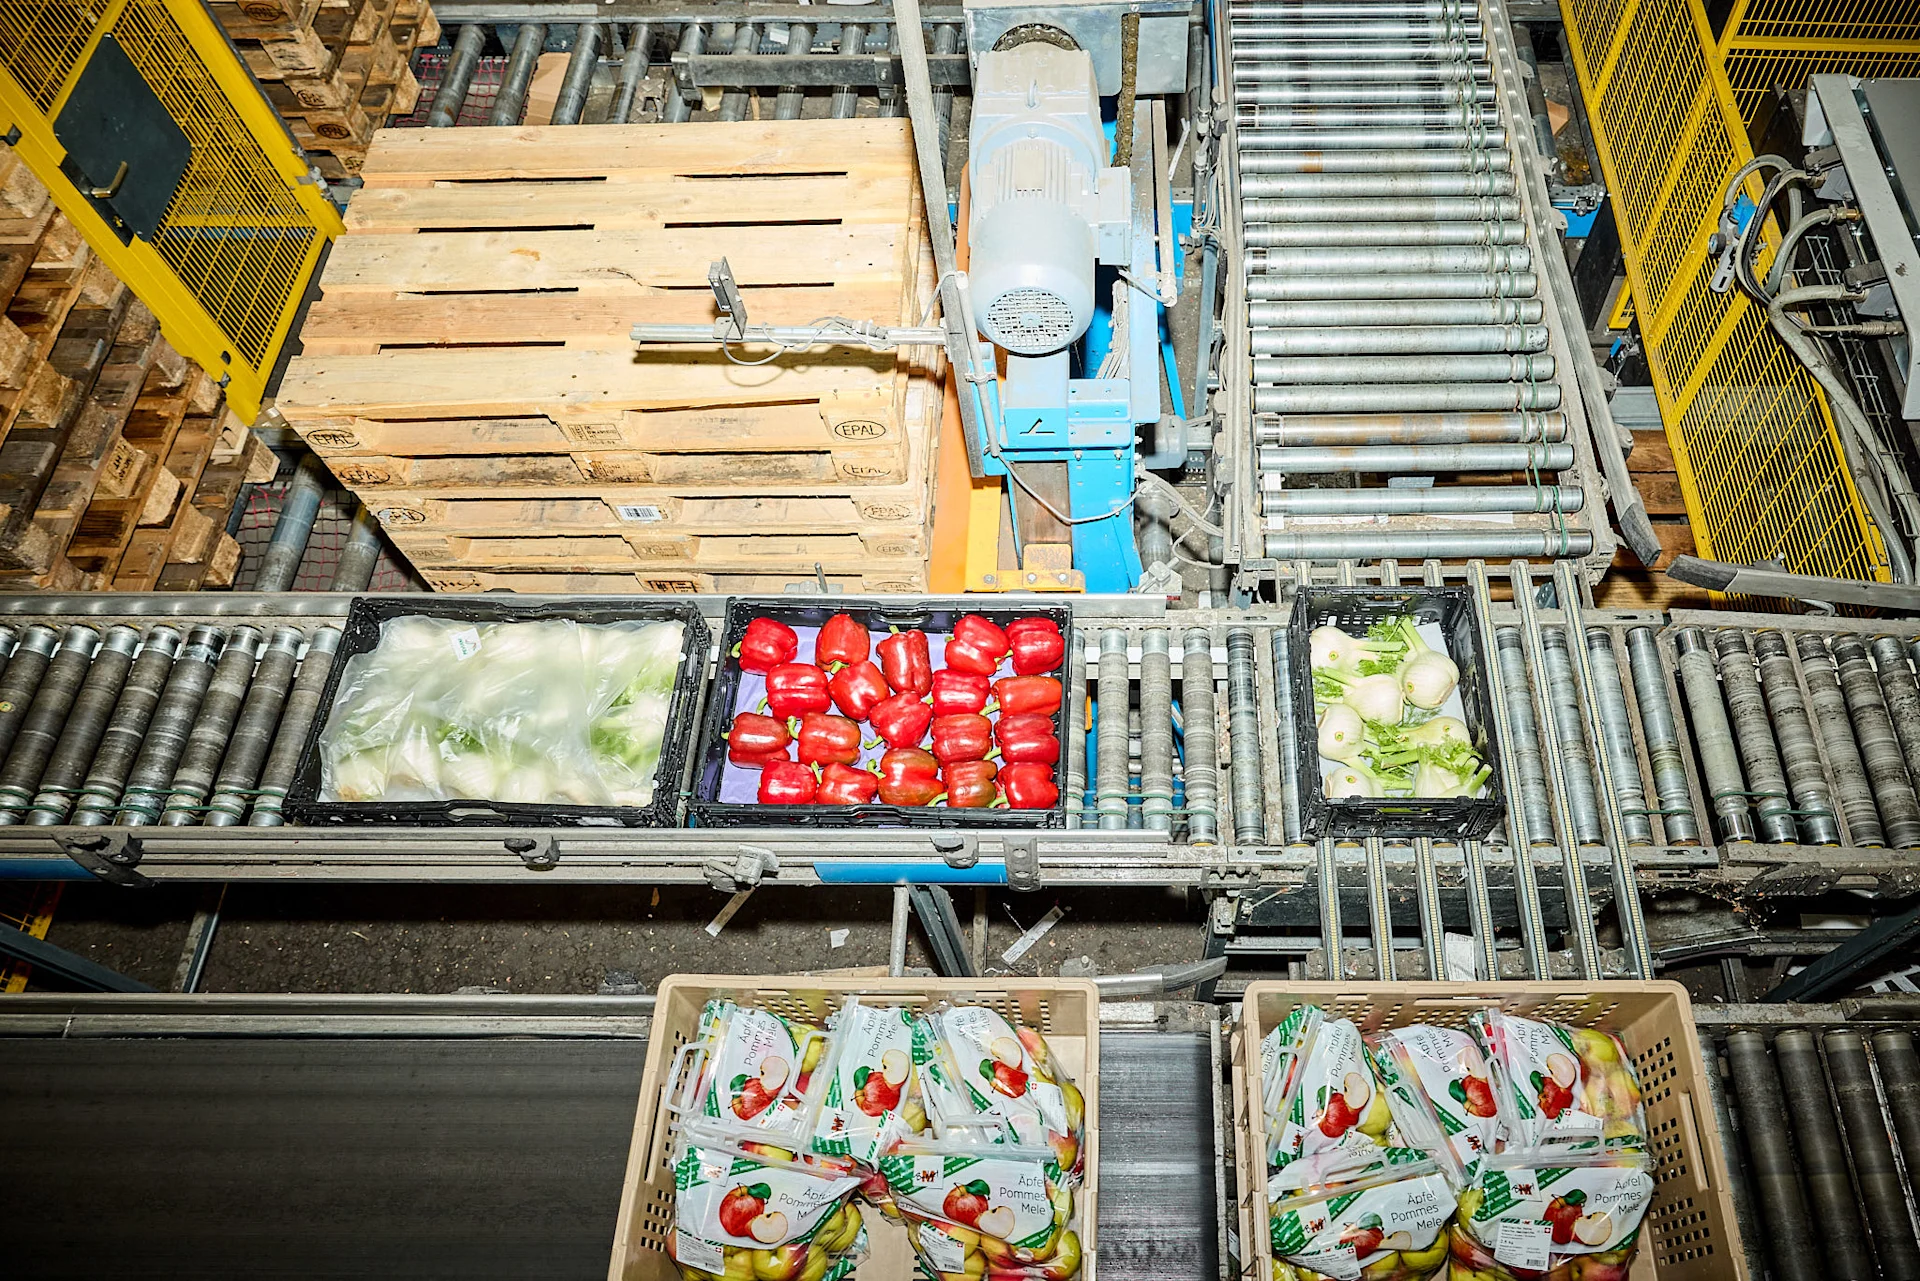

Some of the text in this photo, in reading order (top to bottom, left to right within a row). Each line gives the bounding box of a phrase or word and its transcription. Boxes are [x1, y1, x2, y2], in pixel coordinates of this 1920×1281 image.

[841, 424, 880, 436] EPAL
[312, 433, 352, 445] EPAL
[1330, 1033, 1351, 1078] Pommes
[1018, 1174, 1043, 1187] Äpfe
[1615, 1176, 1641, 1191] Äpfel
[999, 1187, 1046, 1202] Pommes
[1407, 1190, 1437, 1205] Äpfel
[1594, 1191, 1642, 1204] Pommes
[1021, 1203, 1046, 1216] Mele
[1390, 1204, 1439, 1224] Pommes
[1416, 1217, 1443, 1231] Mele
